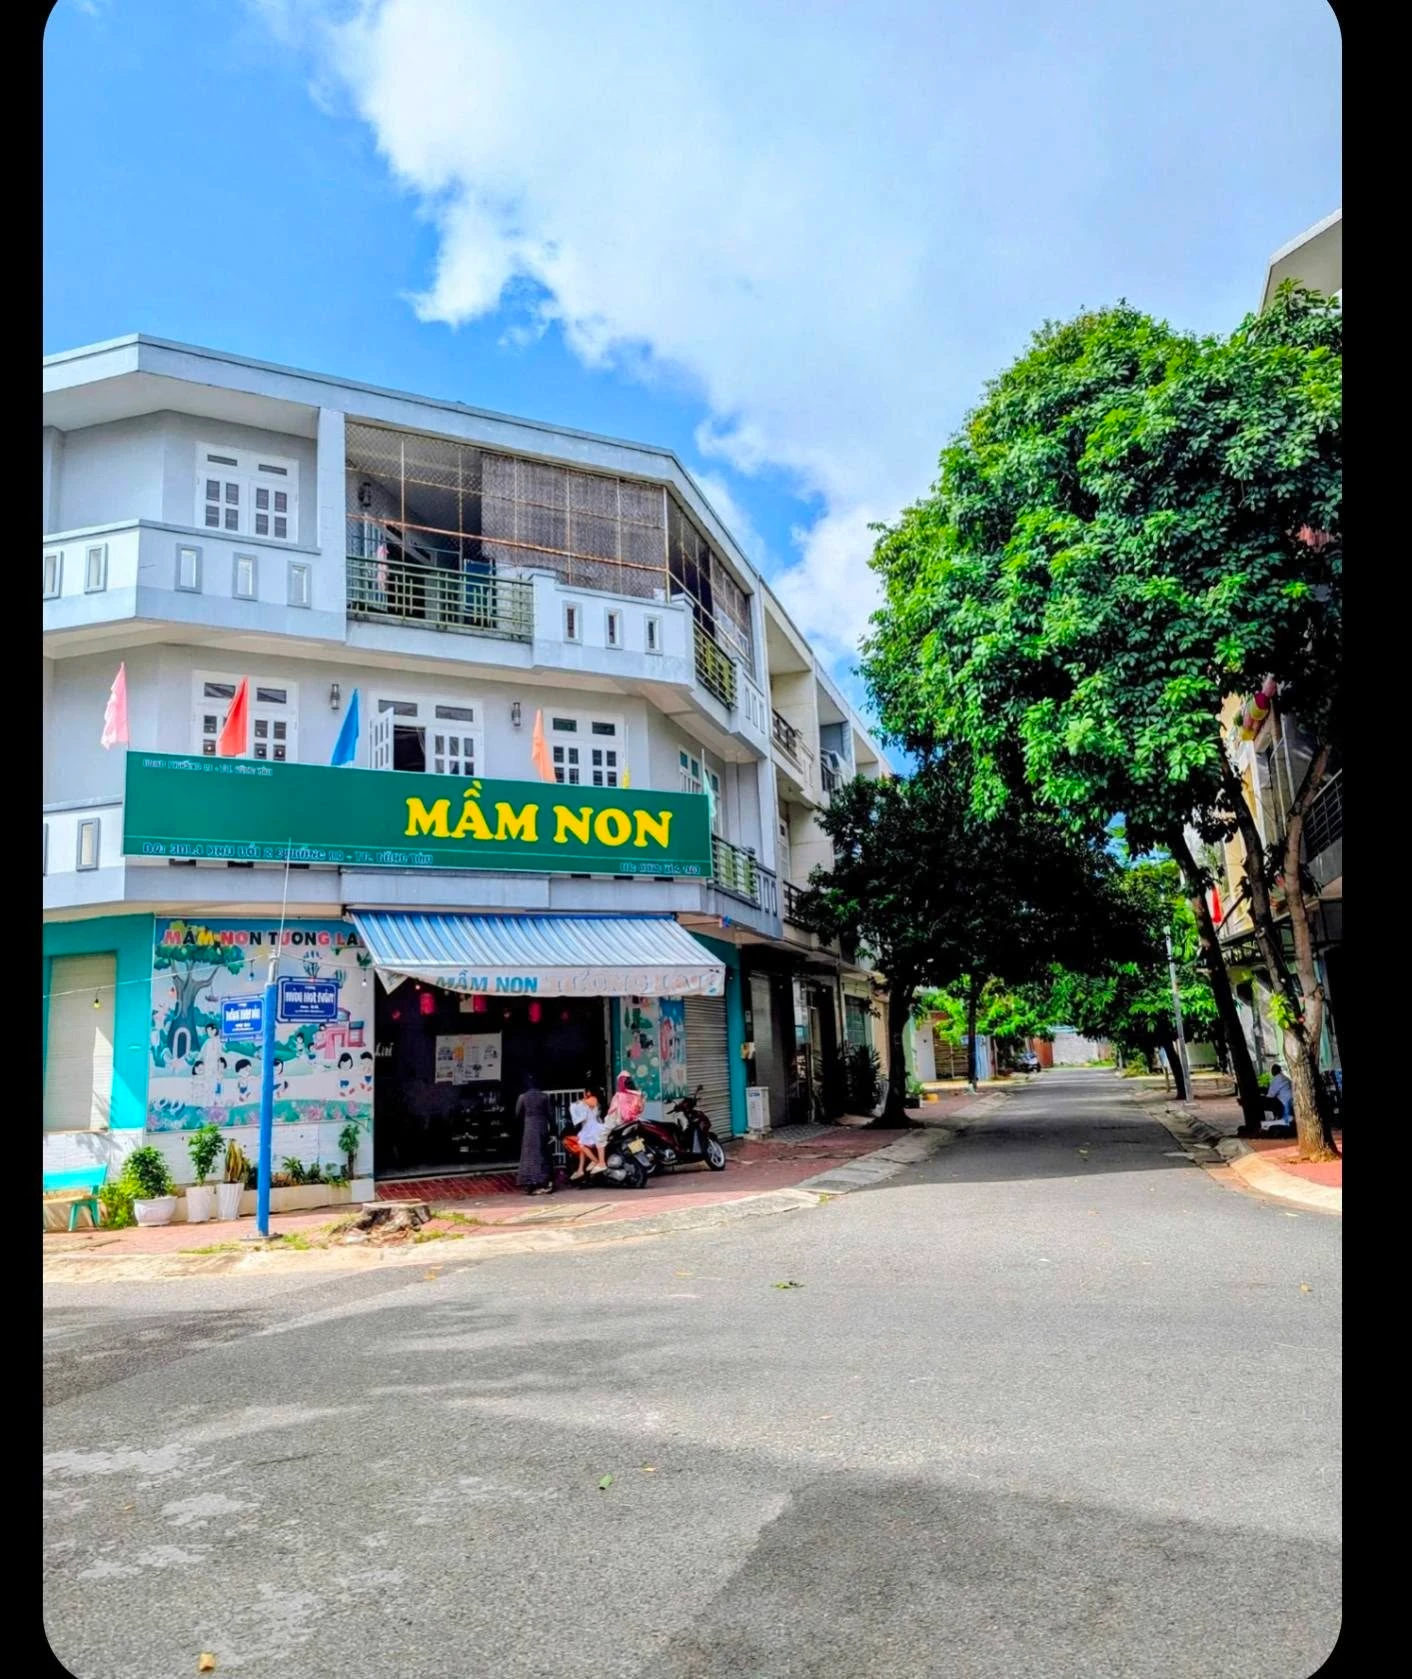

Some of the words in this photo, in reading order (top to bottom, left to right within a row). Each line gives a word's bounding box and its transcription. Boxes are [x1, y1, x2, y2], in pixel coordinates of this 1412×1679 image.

[405, 779, 539, 841] MẦM
[553, 805, 673, 849] NON
[221, 930, 262, 945] NON
[495, 976, 538, 994] NON
